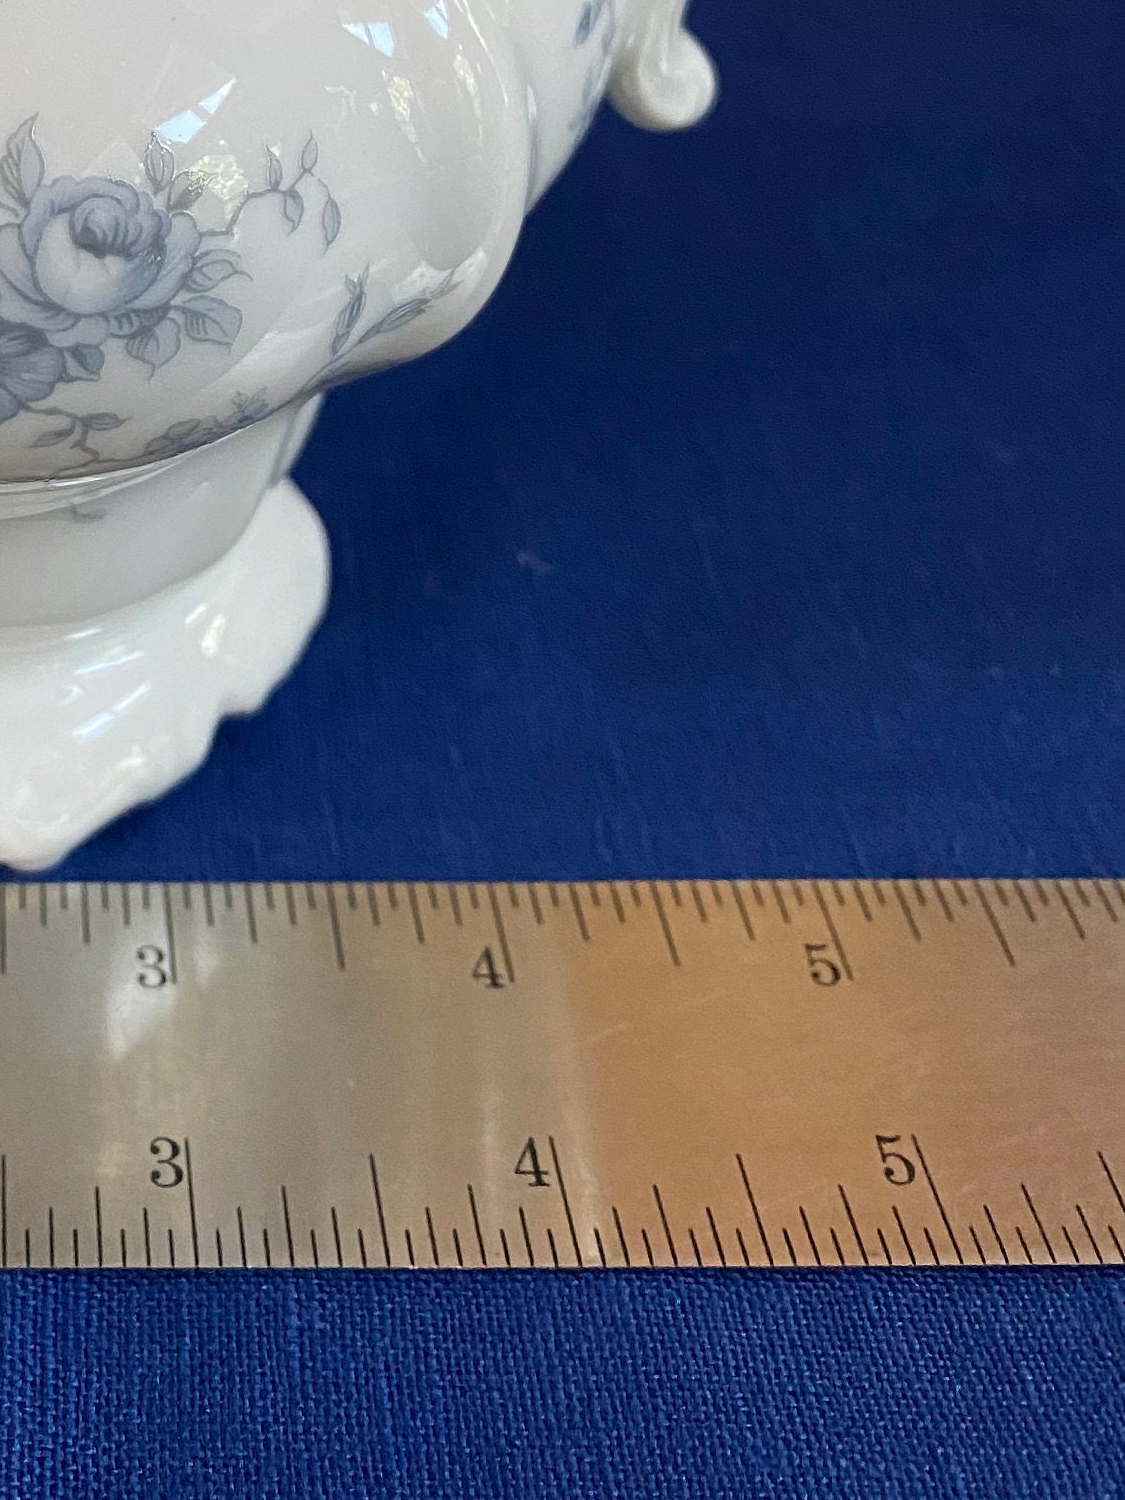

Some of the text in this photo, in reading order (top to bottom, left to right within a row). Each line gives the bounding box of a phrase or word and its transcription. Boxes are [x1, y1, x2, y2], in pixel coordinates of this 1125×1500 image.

[137, 945, 167, 988] 3
[471, 947, 505, 988] 4
[804, 944, 841, 986] 5
[149, 1137, 184, 1188] 3
[514, 1137, 550, 1187] 4
[875, 1135, 916, 1185] 5
